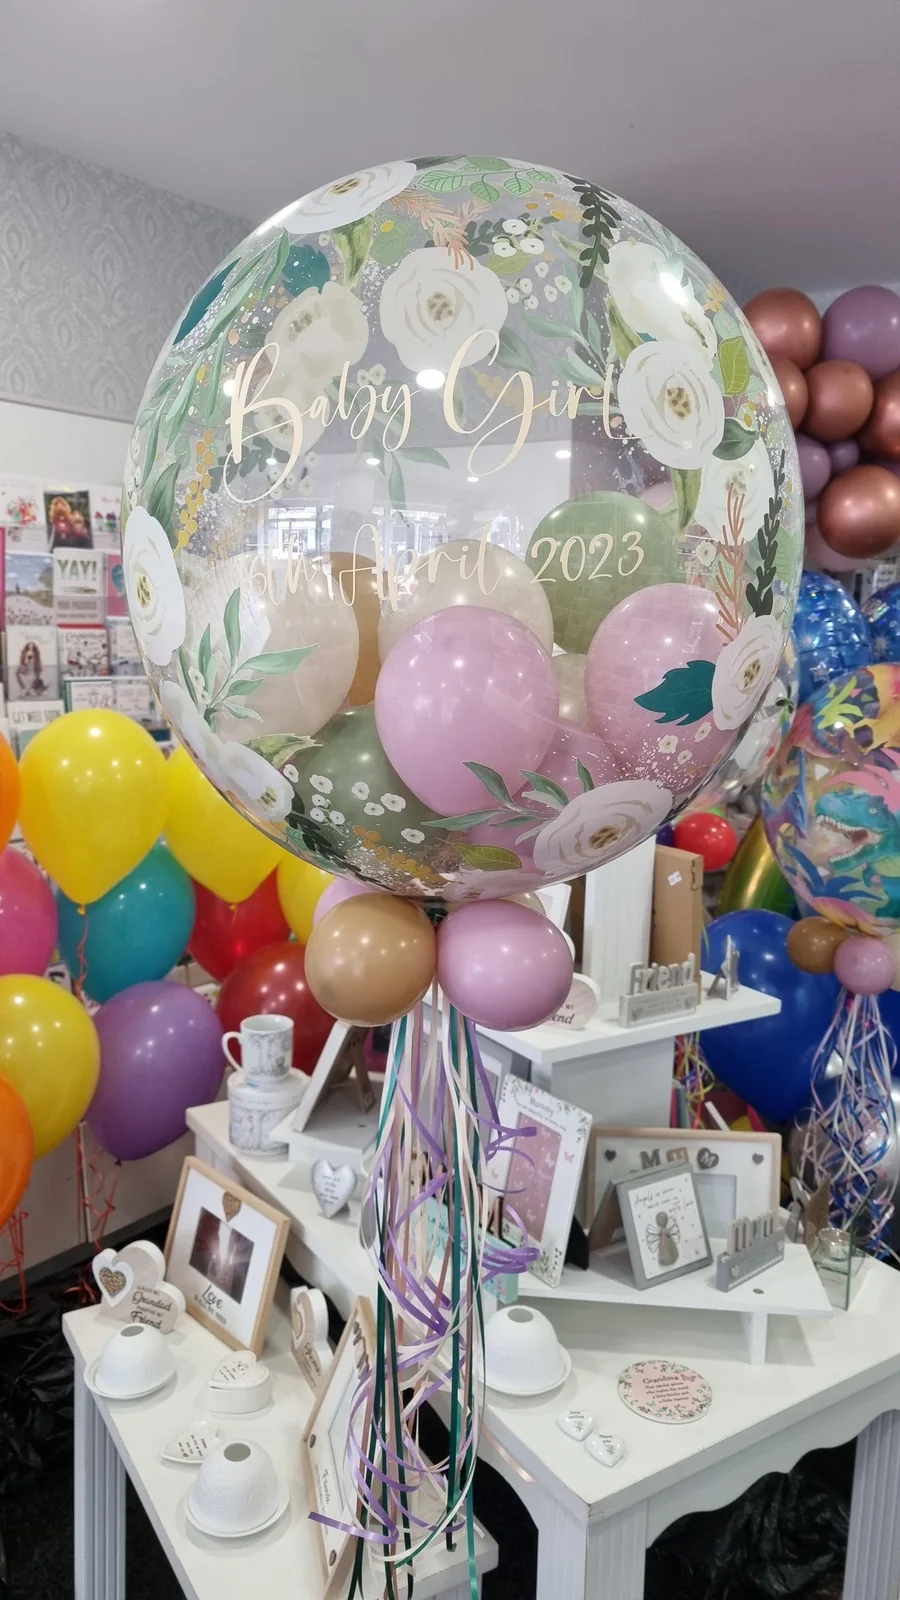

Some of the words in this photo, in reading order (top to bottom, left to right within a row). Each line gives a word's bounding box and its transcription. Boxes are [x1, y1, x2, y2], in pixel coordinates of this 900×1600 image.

[223, 342, 421, 503] Baby
[443, 329, 652, 476] Girl
[56, 559, 97, 581] YAY!
[339, 522, 509, 612] April
[530, 530, 645, 585] 2023
[628, 952, 696, 996] Friend
[132, 1290, 172, 1312] Grandad
[201, 1284, 223, 1310] Love
[130, 1310, 162, 1330] Friend
[643, 1376, 680, 1384] Grandma
